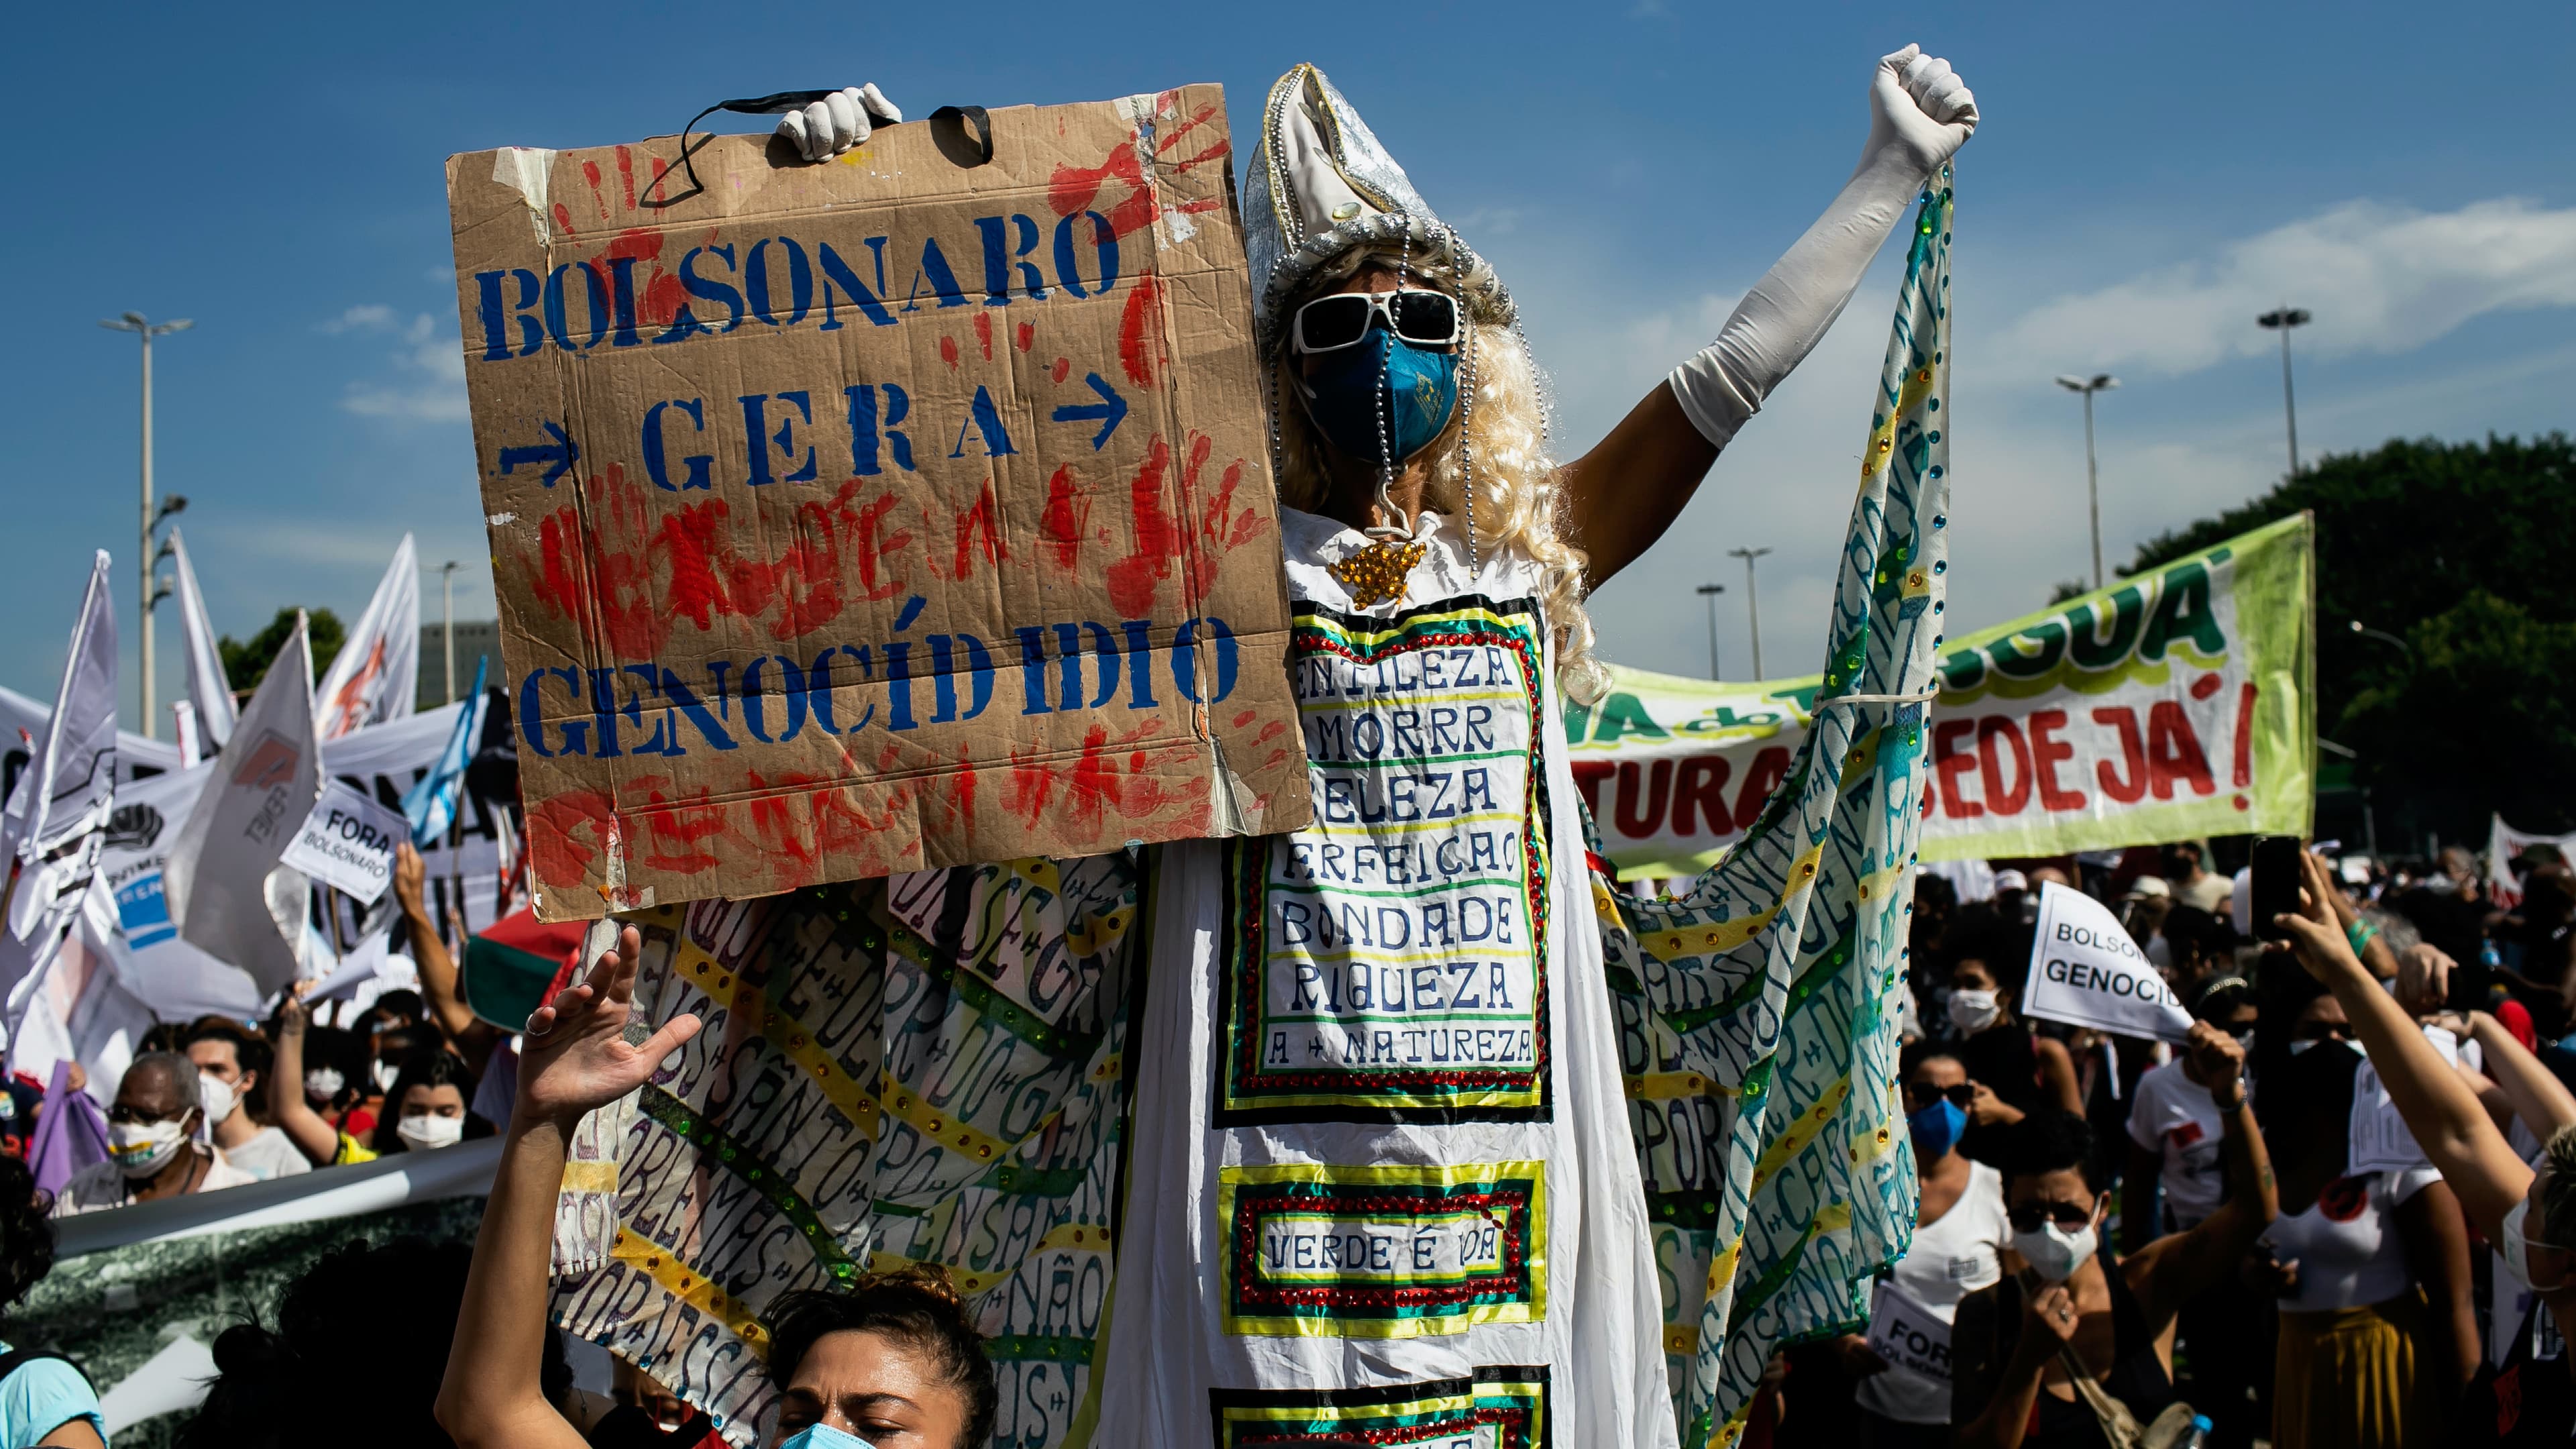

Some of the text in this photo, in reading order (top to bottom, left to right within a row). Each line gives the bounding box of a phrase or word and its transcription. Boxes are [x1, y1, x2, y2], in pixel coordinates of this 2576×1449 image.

[475, 210, 1120, 362] BOLSONARO
[642, 383, 1019, 491] GERA
[1307, 706, 1493, 760] MORRR
[1311, 767, 1497, 822] ELEZA
[325, 809, 390, 856] FORA
[1283, 897, 1513, 951] BONDADE
[1291, 962, 1513, 1012] RIQUEZA
[1268, 1031, 1289, 1064] A
[1343, 1029, 1532, 1063] NATUREZA
[1267, 1234, 1392, 1271] VERDE
